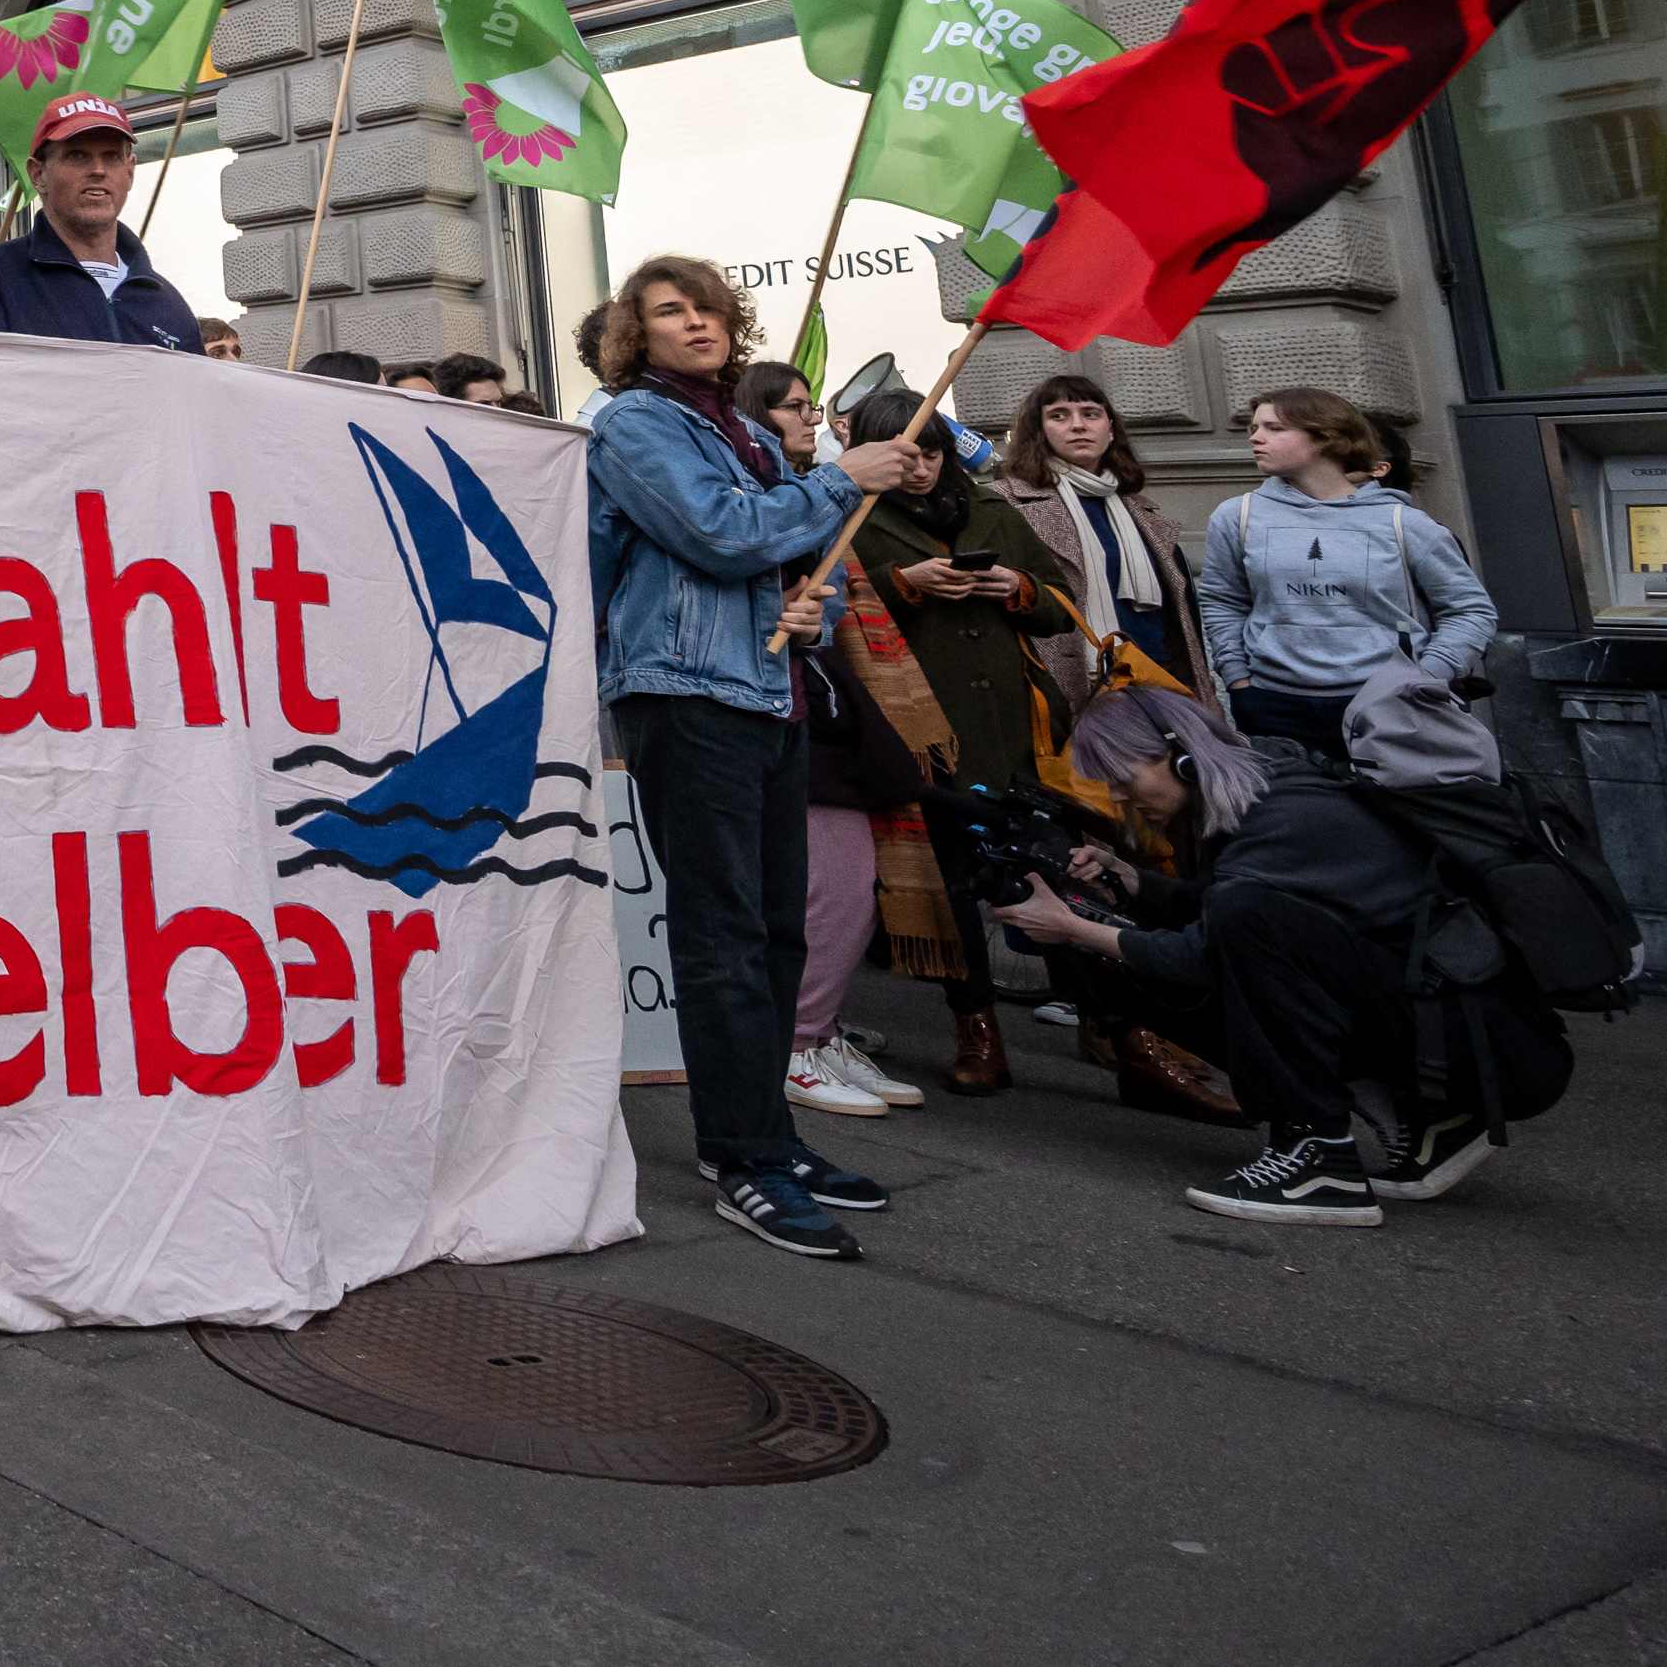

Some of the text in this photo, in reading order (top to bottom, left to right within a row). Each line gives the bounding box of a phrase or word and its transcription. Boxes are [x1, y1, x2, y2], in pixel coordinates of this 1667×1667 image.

[903, 74, 1034, 138] giova
[723, 246, 914, 289] EDIT SUISSE
[1286, 582, 1347, 597] NIKIN
